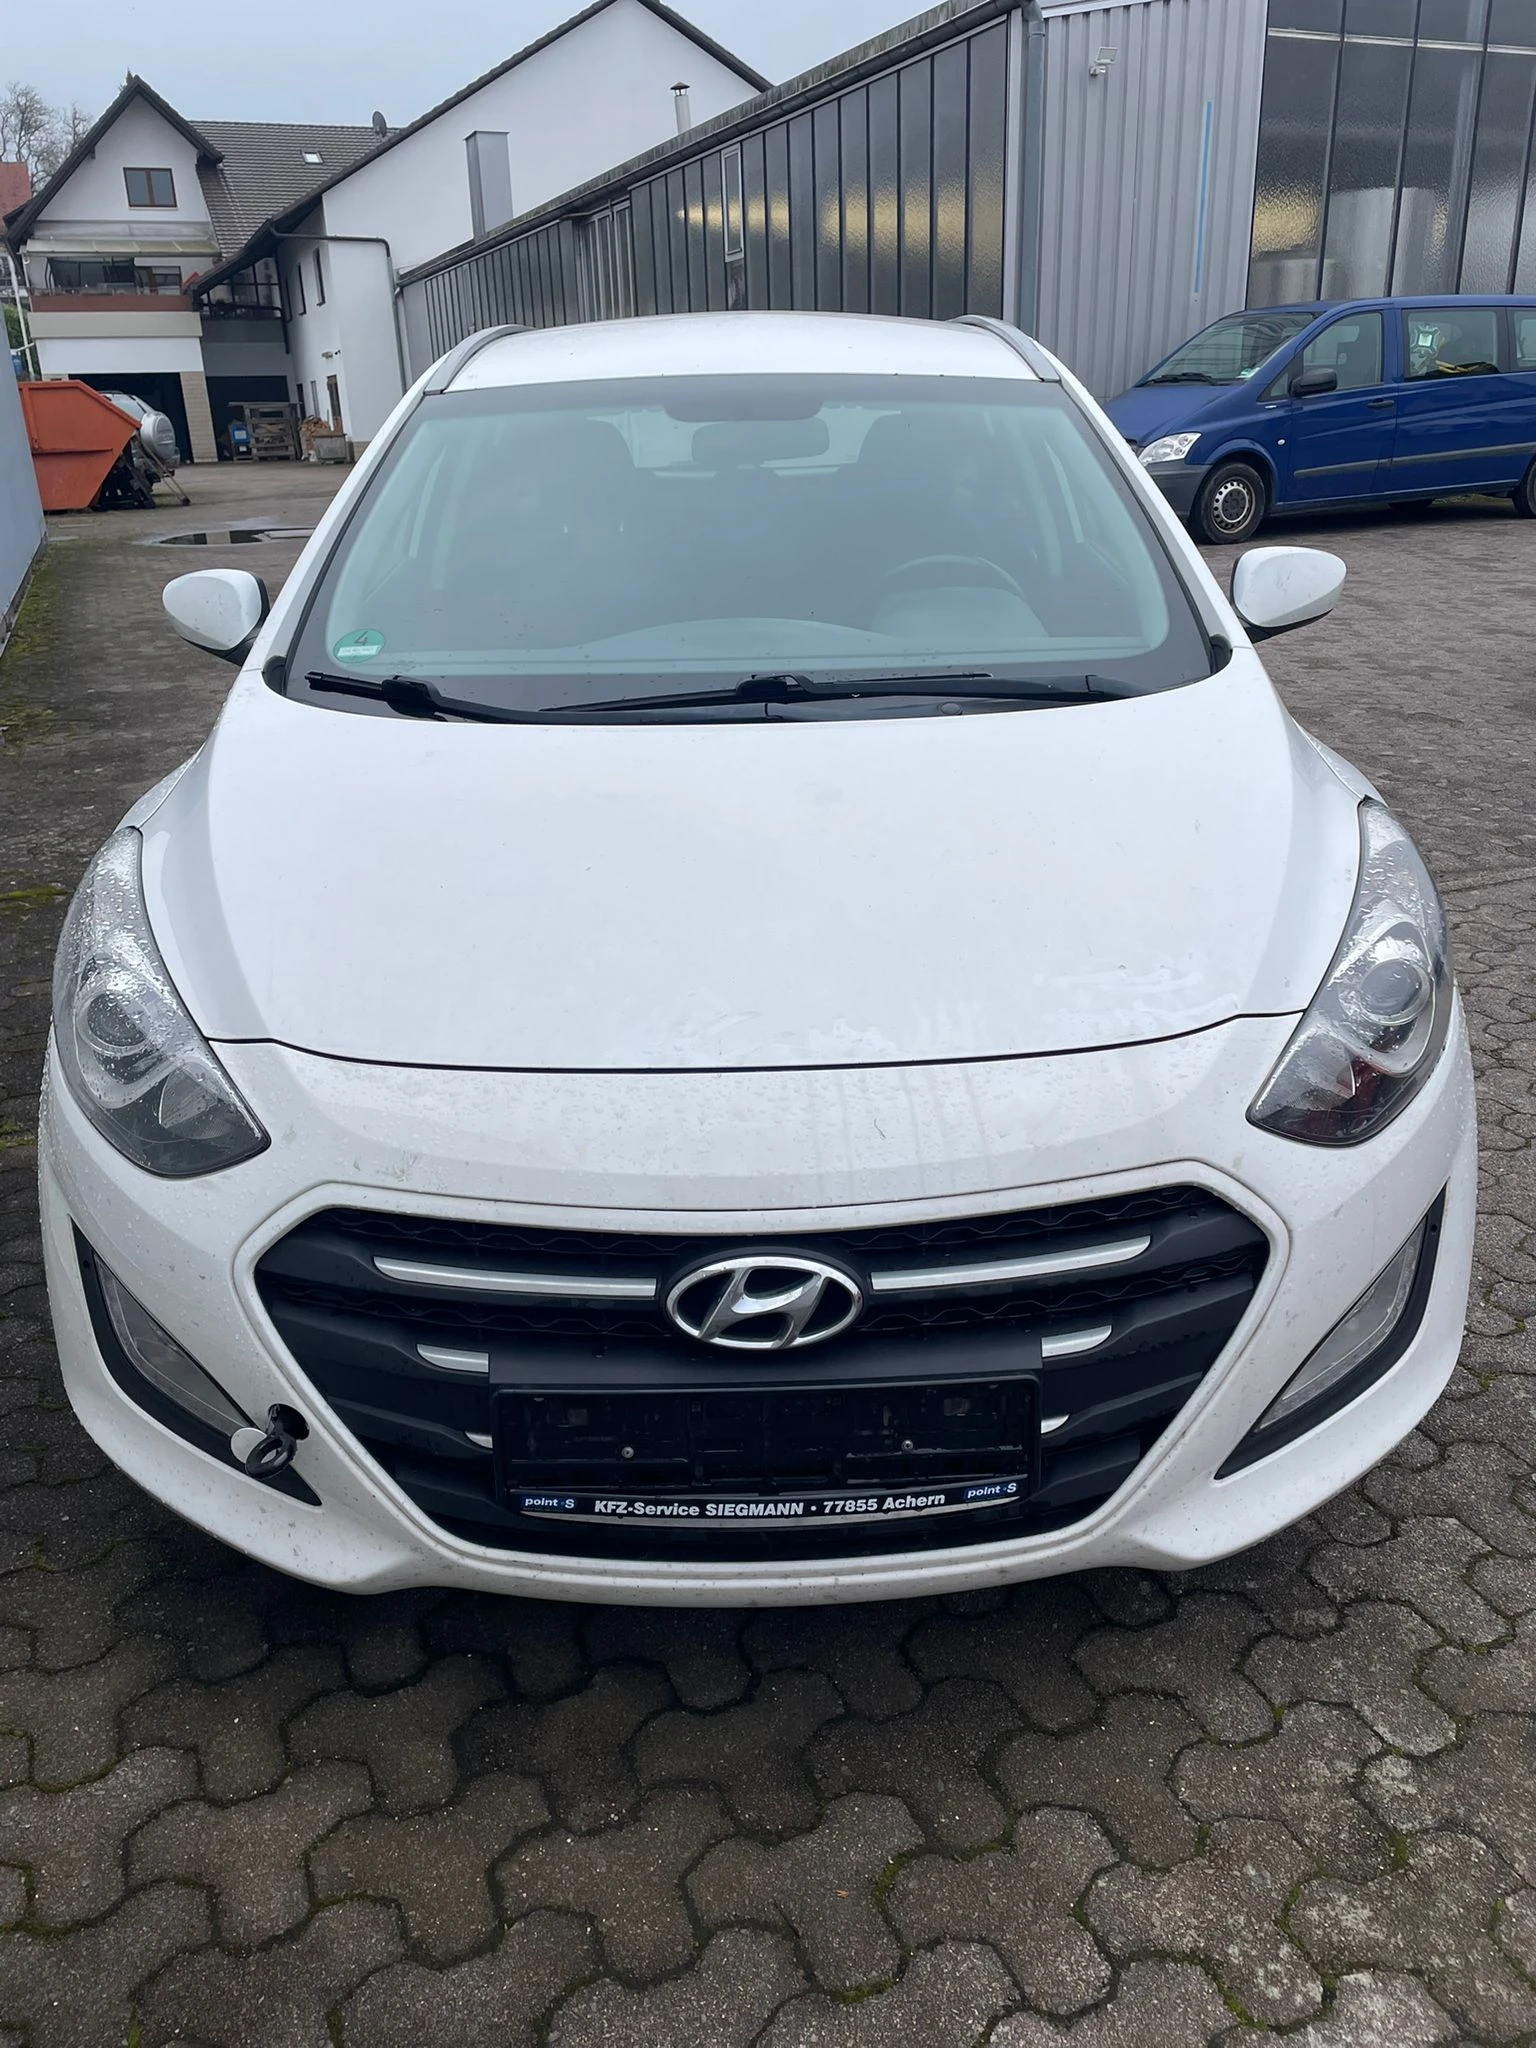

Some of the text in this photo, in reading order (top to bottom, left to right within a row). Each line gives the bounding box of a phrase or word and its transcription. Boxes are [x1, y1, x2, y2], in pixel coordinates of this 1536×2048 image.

[353, 630, 369, 646] 4
[967, 1485, 1001, 1499] point
[525, 1497, 558, 1507] point
[594, 1494, 946, 1517] KFZ-Service SIEGMANN 77855 Achern
